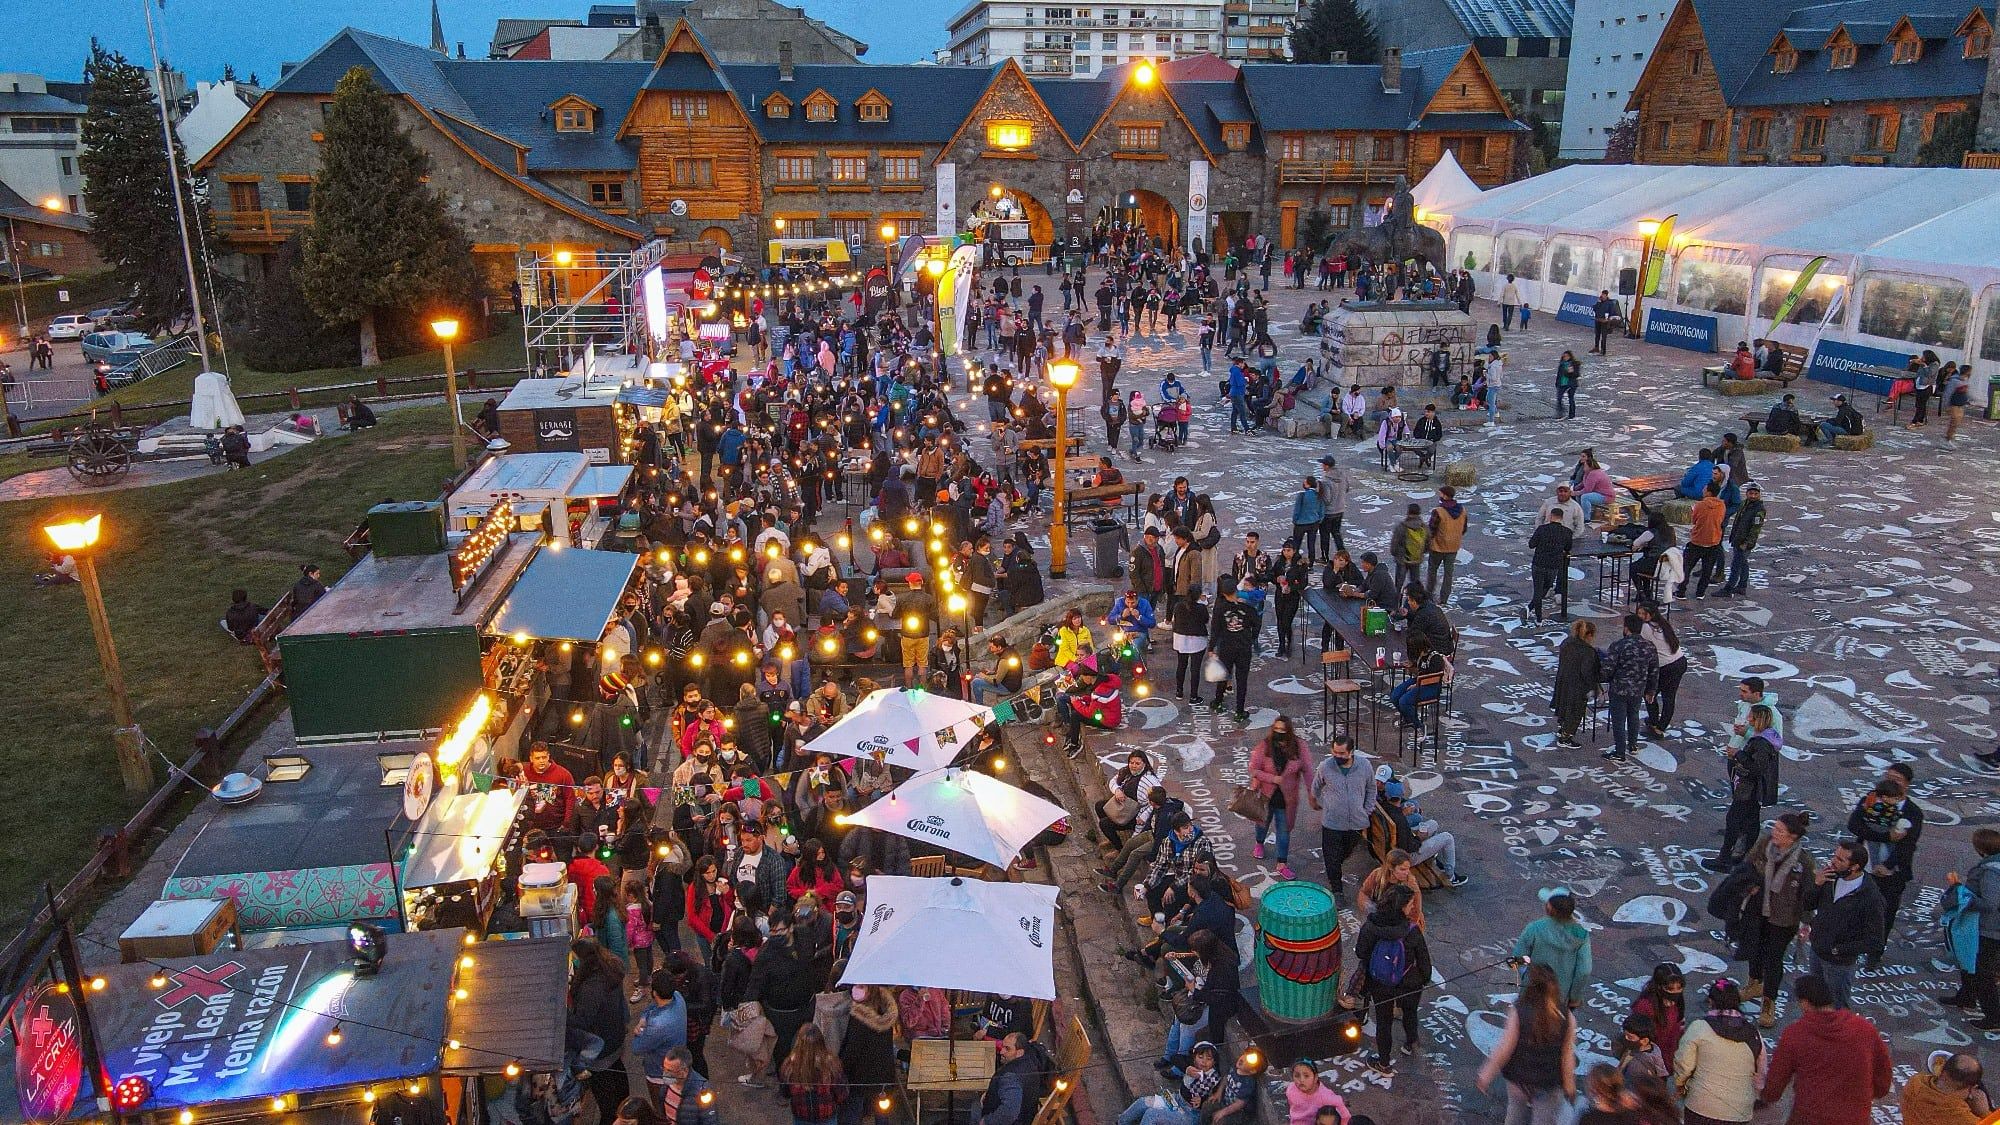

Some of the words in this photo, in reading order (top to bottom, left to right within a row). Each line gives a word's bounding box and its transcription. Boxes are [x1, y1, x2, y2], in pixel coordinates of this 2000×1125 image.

[869, 286, 889, 298] Blest
[1407, 325, 1463, 344] FUERA
[1649, 320, 1708, 340] BANCOPATAGONIA
[1219, 768, 1236, 784] ERP
[1233, 746, 1250, 789] SANTUCH
[906, 819, 951, 840] Corona
[1181, 779, 1238, 873] MONTONEROS
[1500, 816, 1531, 857] GOGO
[869, 903, 888, 936] Corona
[1028, 916, 1043, 948] Corona
[245, 964, 290, 1017] razón
[183, 989, 235, 1040] Lean
[132, 1011, 187, 1066] viejo
[26, 1073, 46, 1103] LA
[44, 1016, 75, 1070] CRUZ
[163, 1043, 213, 1087] Mc.
